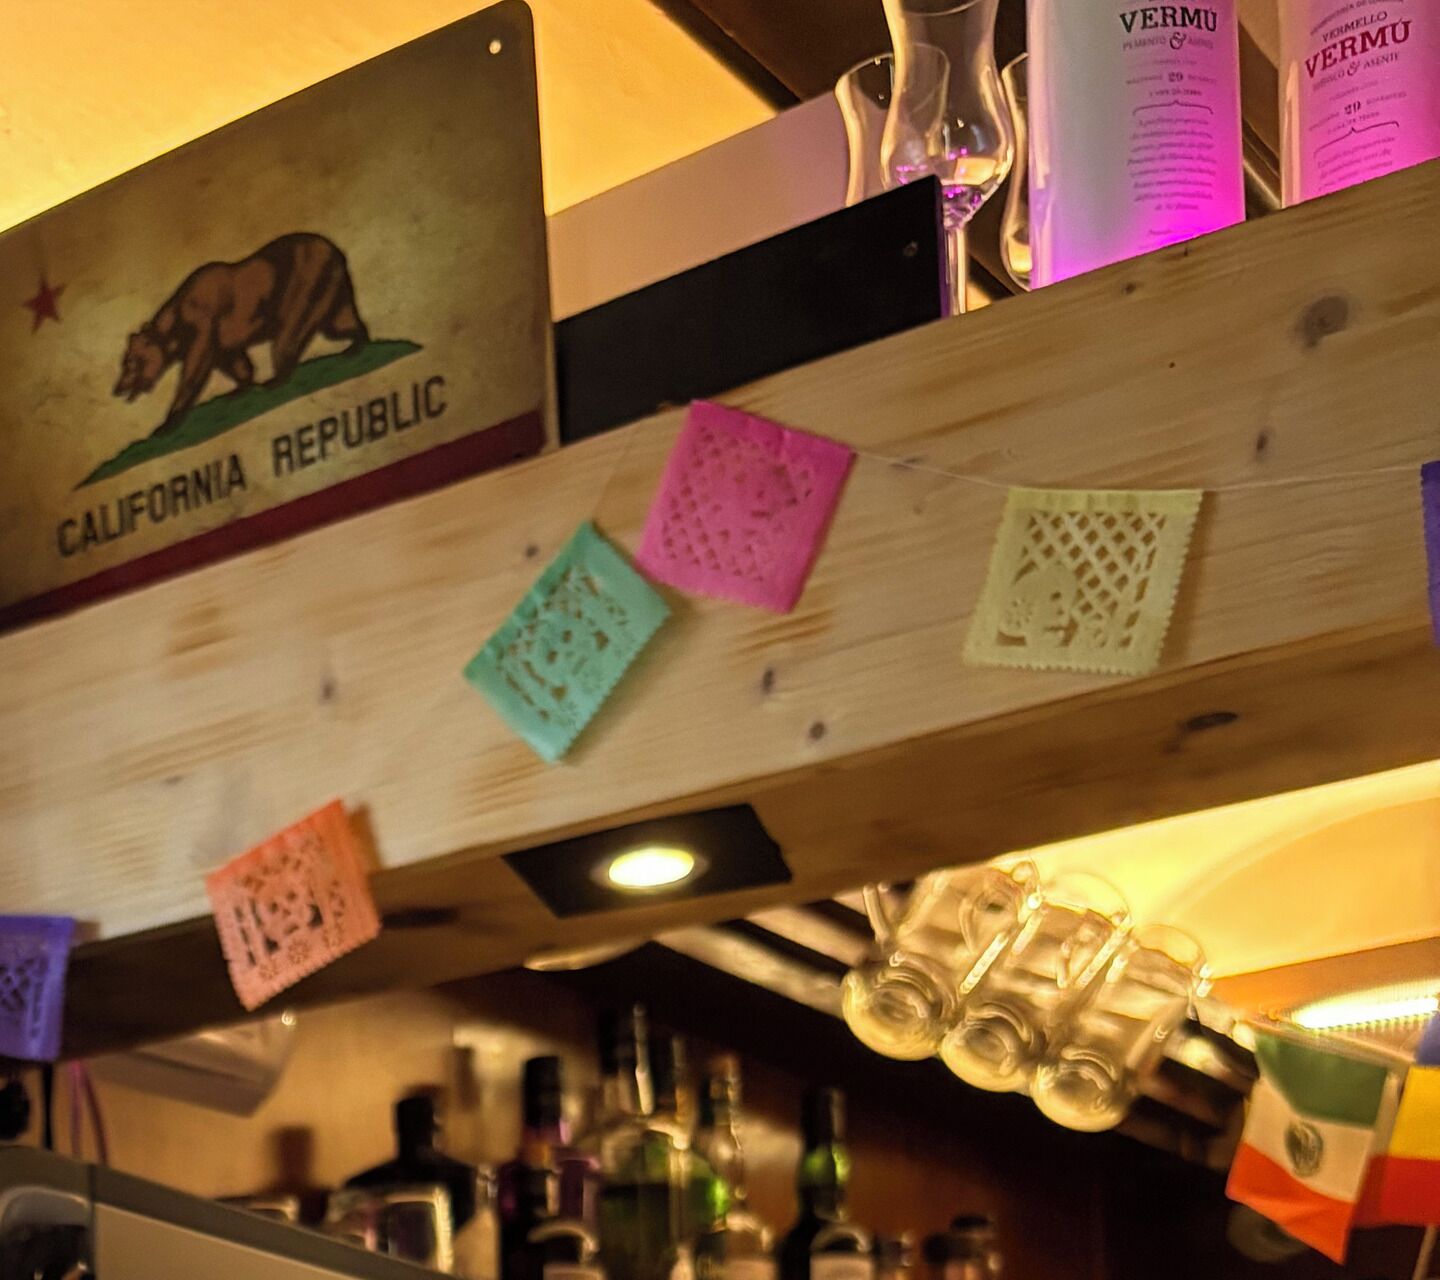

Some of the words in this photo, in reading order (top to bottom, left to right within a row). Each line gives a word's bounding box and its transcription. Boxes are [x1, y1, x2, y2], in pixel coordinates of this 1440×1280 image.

[1120, 7, 1217, 33] VERMÚ
[1169, 32, 1186, 49] &
[1305, 18, 1413, 78] VERMÚ
[56, 453, 247, 558] CALIFORNIA
[271, 375, 448, 478] REPUBLIC
